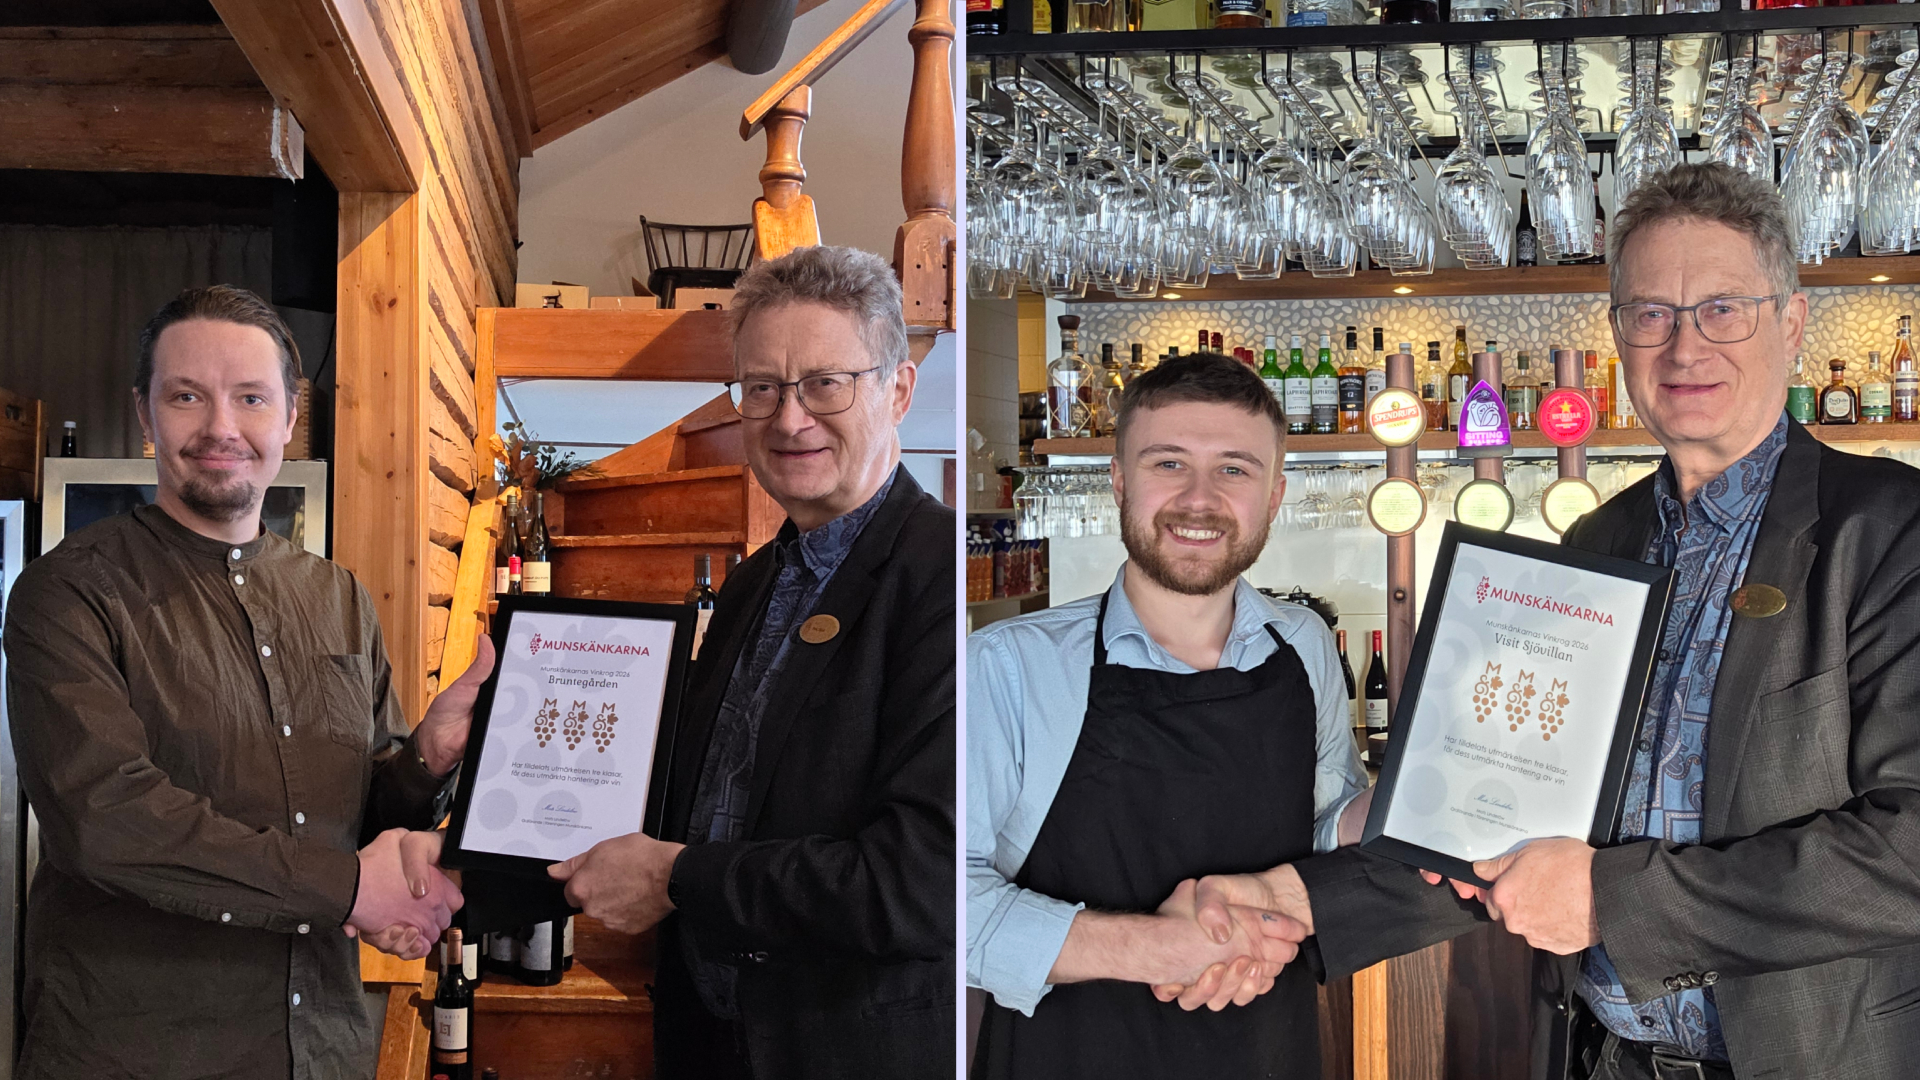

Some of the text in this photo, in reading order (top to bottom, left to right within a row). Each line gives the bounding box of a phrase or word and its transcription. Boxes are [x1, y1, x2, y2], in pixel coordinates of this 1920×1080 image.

[1374, 407, 1417, 422] SPENDRUPS
[1465, 431, 1504, 440] SITTING
[1490, 587, 1614, 626] MUNSKÄNKARNA
[1486, 620, 1589, 650] Munskänkarnas Vinkrog 2026
[542, 640, 650, 656] MUNSKÄNKARNA
[1495, 633, 1573, 662] Visit Sjövillan
[540, 666, 589, 675] Munskänkarnas
[590, 669, 614, 677] Vinkrog
[548, 675, 618, 689] Bruntegården
[1444, 735, 1569, 777] Har tilldelats utmärkelsen tre klasar,
[524, 763, 550, 771] tilldelats
[551, 766, 591, 775] utmärkelsen
[1443, 745, 1452, 753] för
[1454, 748, 1470, 759] dess
[1471, 754, 1504, 768] utmärkta
[1505, 763, 1541, 780] hantering
[1554, 777, 1565, 786] vin
[536, 773, 566, 781] utmärkta
[567, 775, 600, 785] hantering
